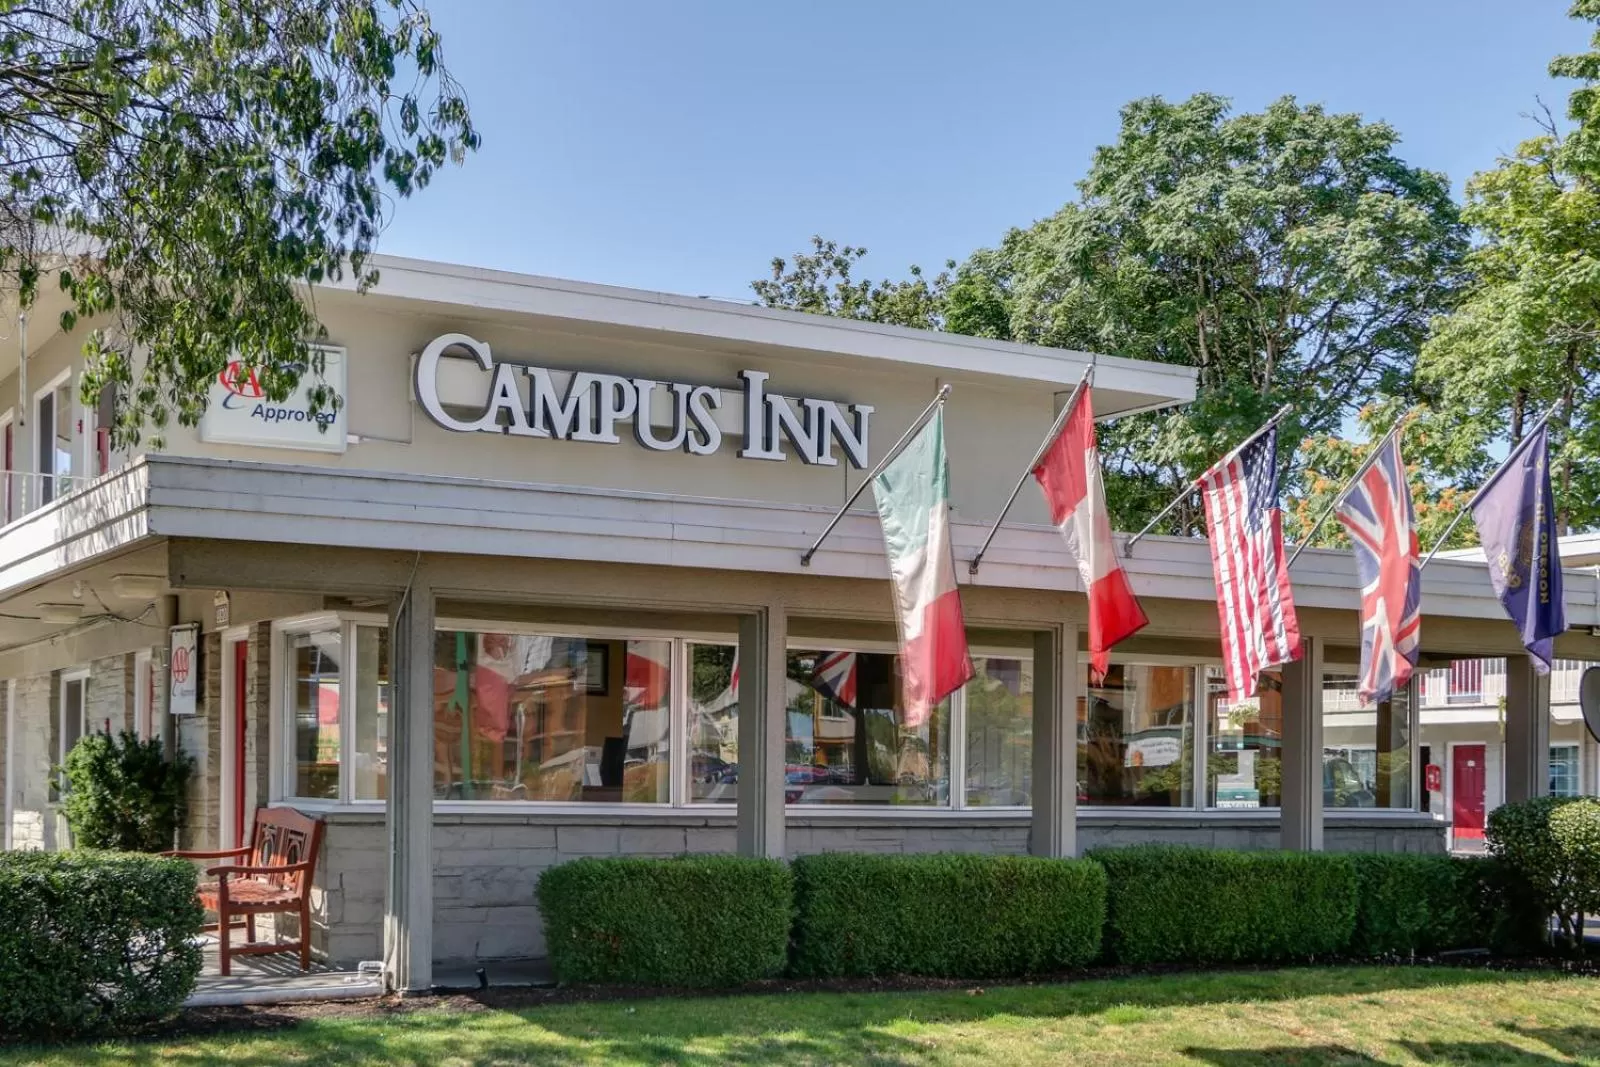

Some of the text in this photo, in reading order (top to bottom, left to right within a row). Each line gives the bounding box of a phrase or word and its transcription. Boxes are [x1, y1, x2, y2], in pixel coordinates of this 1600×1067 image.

[251, 403, 337, 424] Approved
[414, 333, 875, 469] CAMPUS INN
[1540, 532, 1550, 604] OREGON
